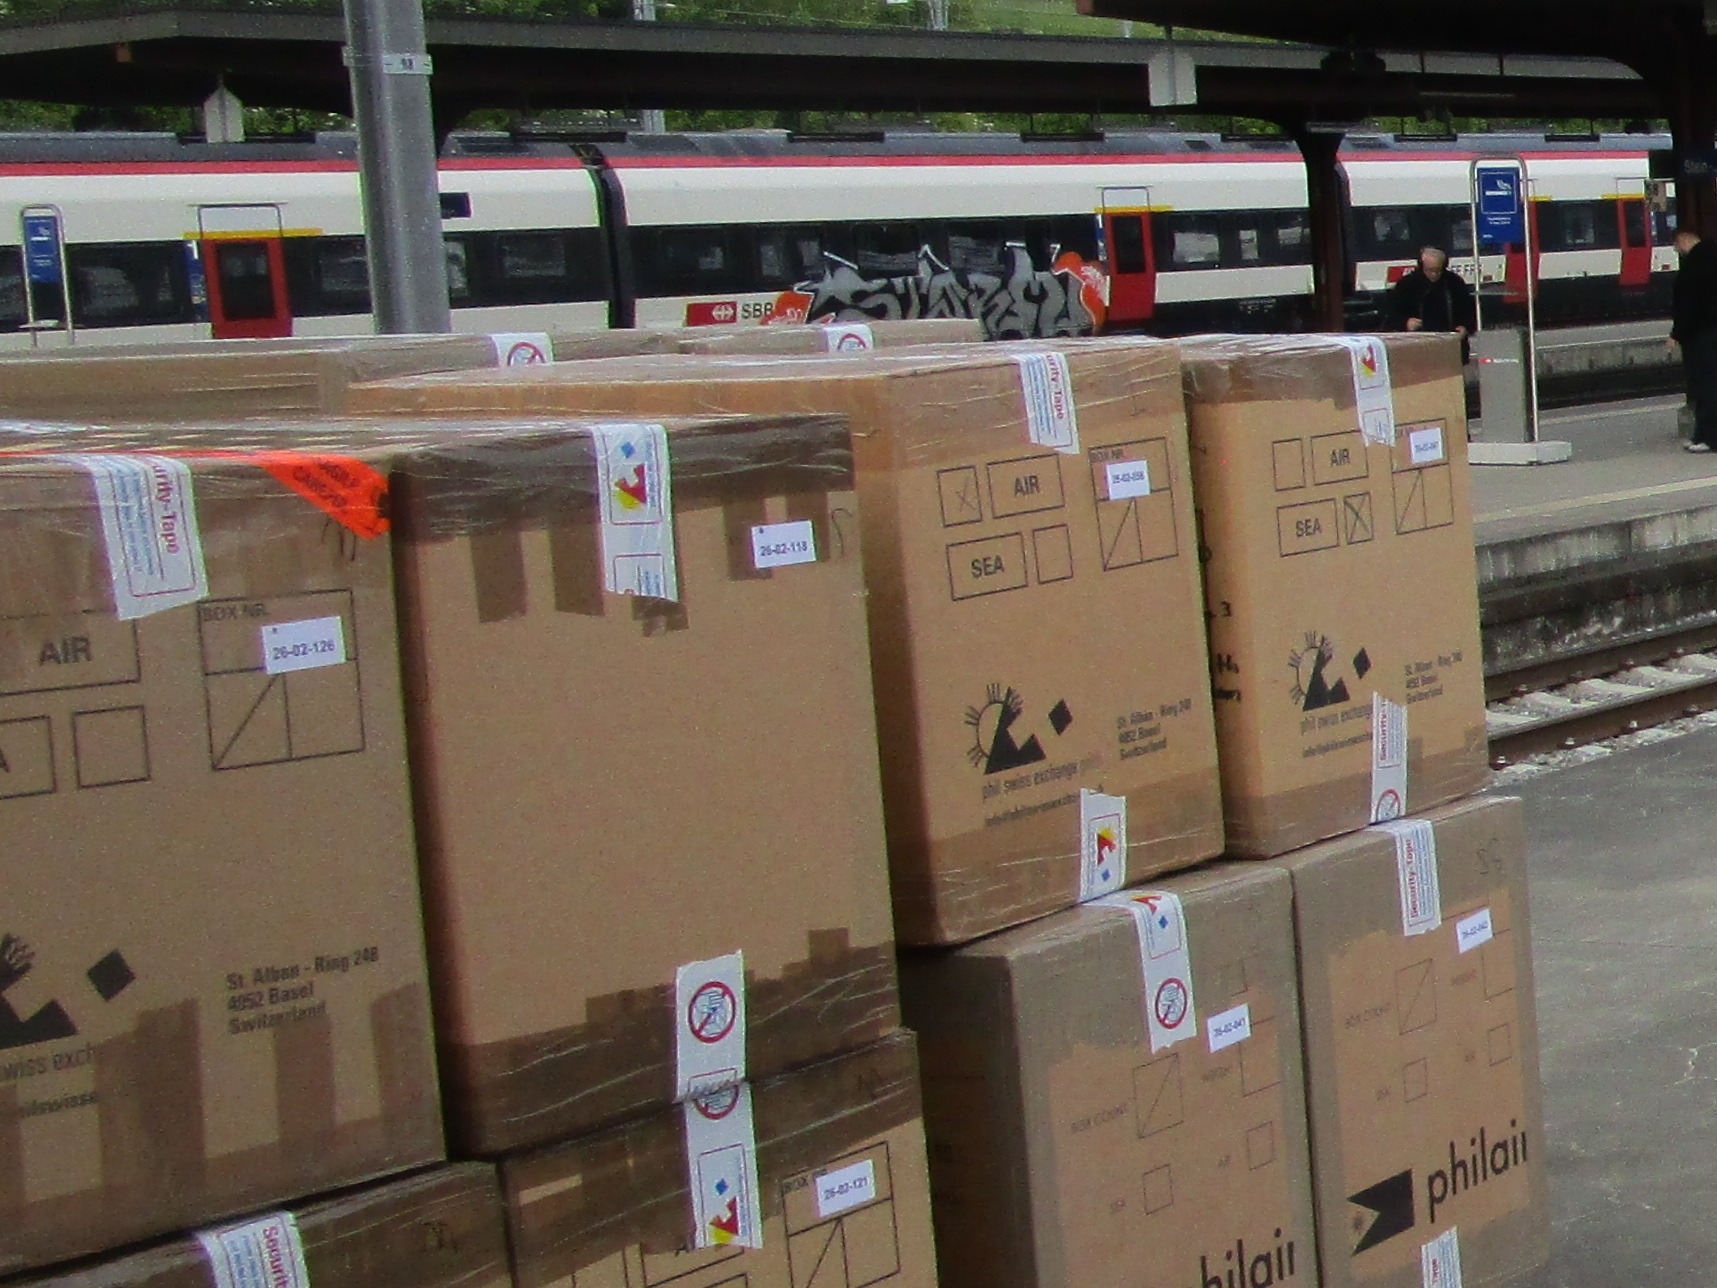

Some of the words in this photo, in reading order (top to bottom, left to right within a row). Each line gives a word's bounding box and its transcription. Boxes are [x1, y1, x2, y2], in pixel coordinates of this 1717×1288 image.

[741, 302, 773, 320] SBB
[1329, 447, 1352, 468] AIR
[1014, 474, 1041, 497] AIR
[1295, 517, 1322, 538] SEA
[970, 555, 1006, 578] SEA
[39, 635, 93, 666] AIR
[269, 980, 314, 1005] Basel
